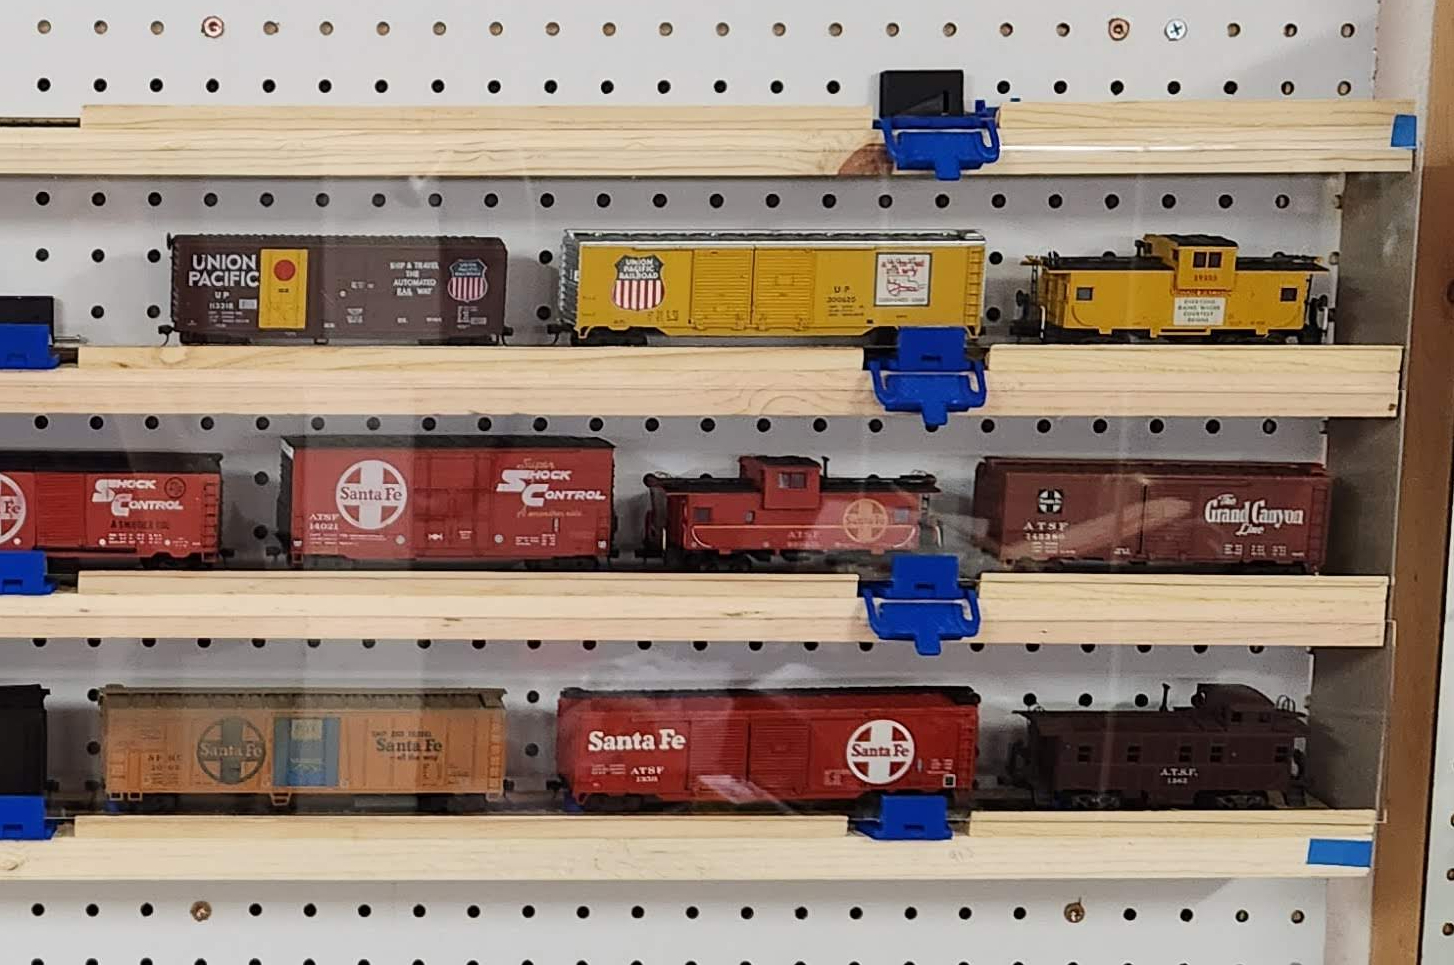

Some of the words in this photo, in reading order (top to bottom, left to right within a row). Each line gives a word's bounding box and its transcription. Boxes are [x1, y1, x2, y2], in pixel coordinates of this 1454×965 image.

[192, 254, 257, 270] UNION
[188, 271, 259, 287] PACIFIC
[340, 486, 382, 500] Santa
[385, 487, 403, 501] Fe
[4, 499, 21, 514] Fe
[1205, 500, 1251, 523] Grand
[1251, 500, 1304, 528] Canyon
[1023, 521, 1069, 530] ATSF
[1235, 523, 1265, 535] Line
[376, 737, 423, 752] Santa
[425, 738, 443, 752] Fe
[588, 730, 656, 751] Santa
[658, 728, 687, 750] Fe
[199, 742, 243, 757] Santa
[245, 742, 264, 758] Fe
[851, 743, 891, 757] Santa
[893, 743, 910, 757] Fe
[630, 766, 665, 774] ATSF
